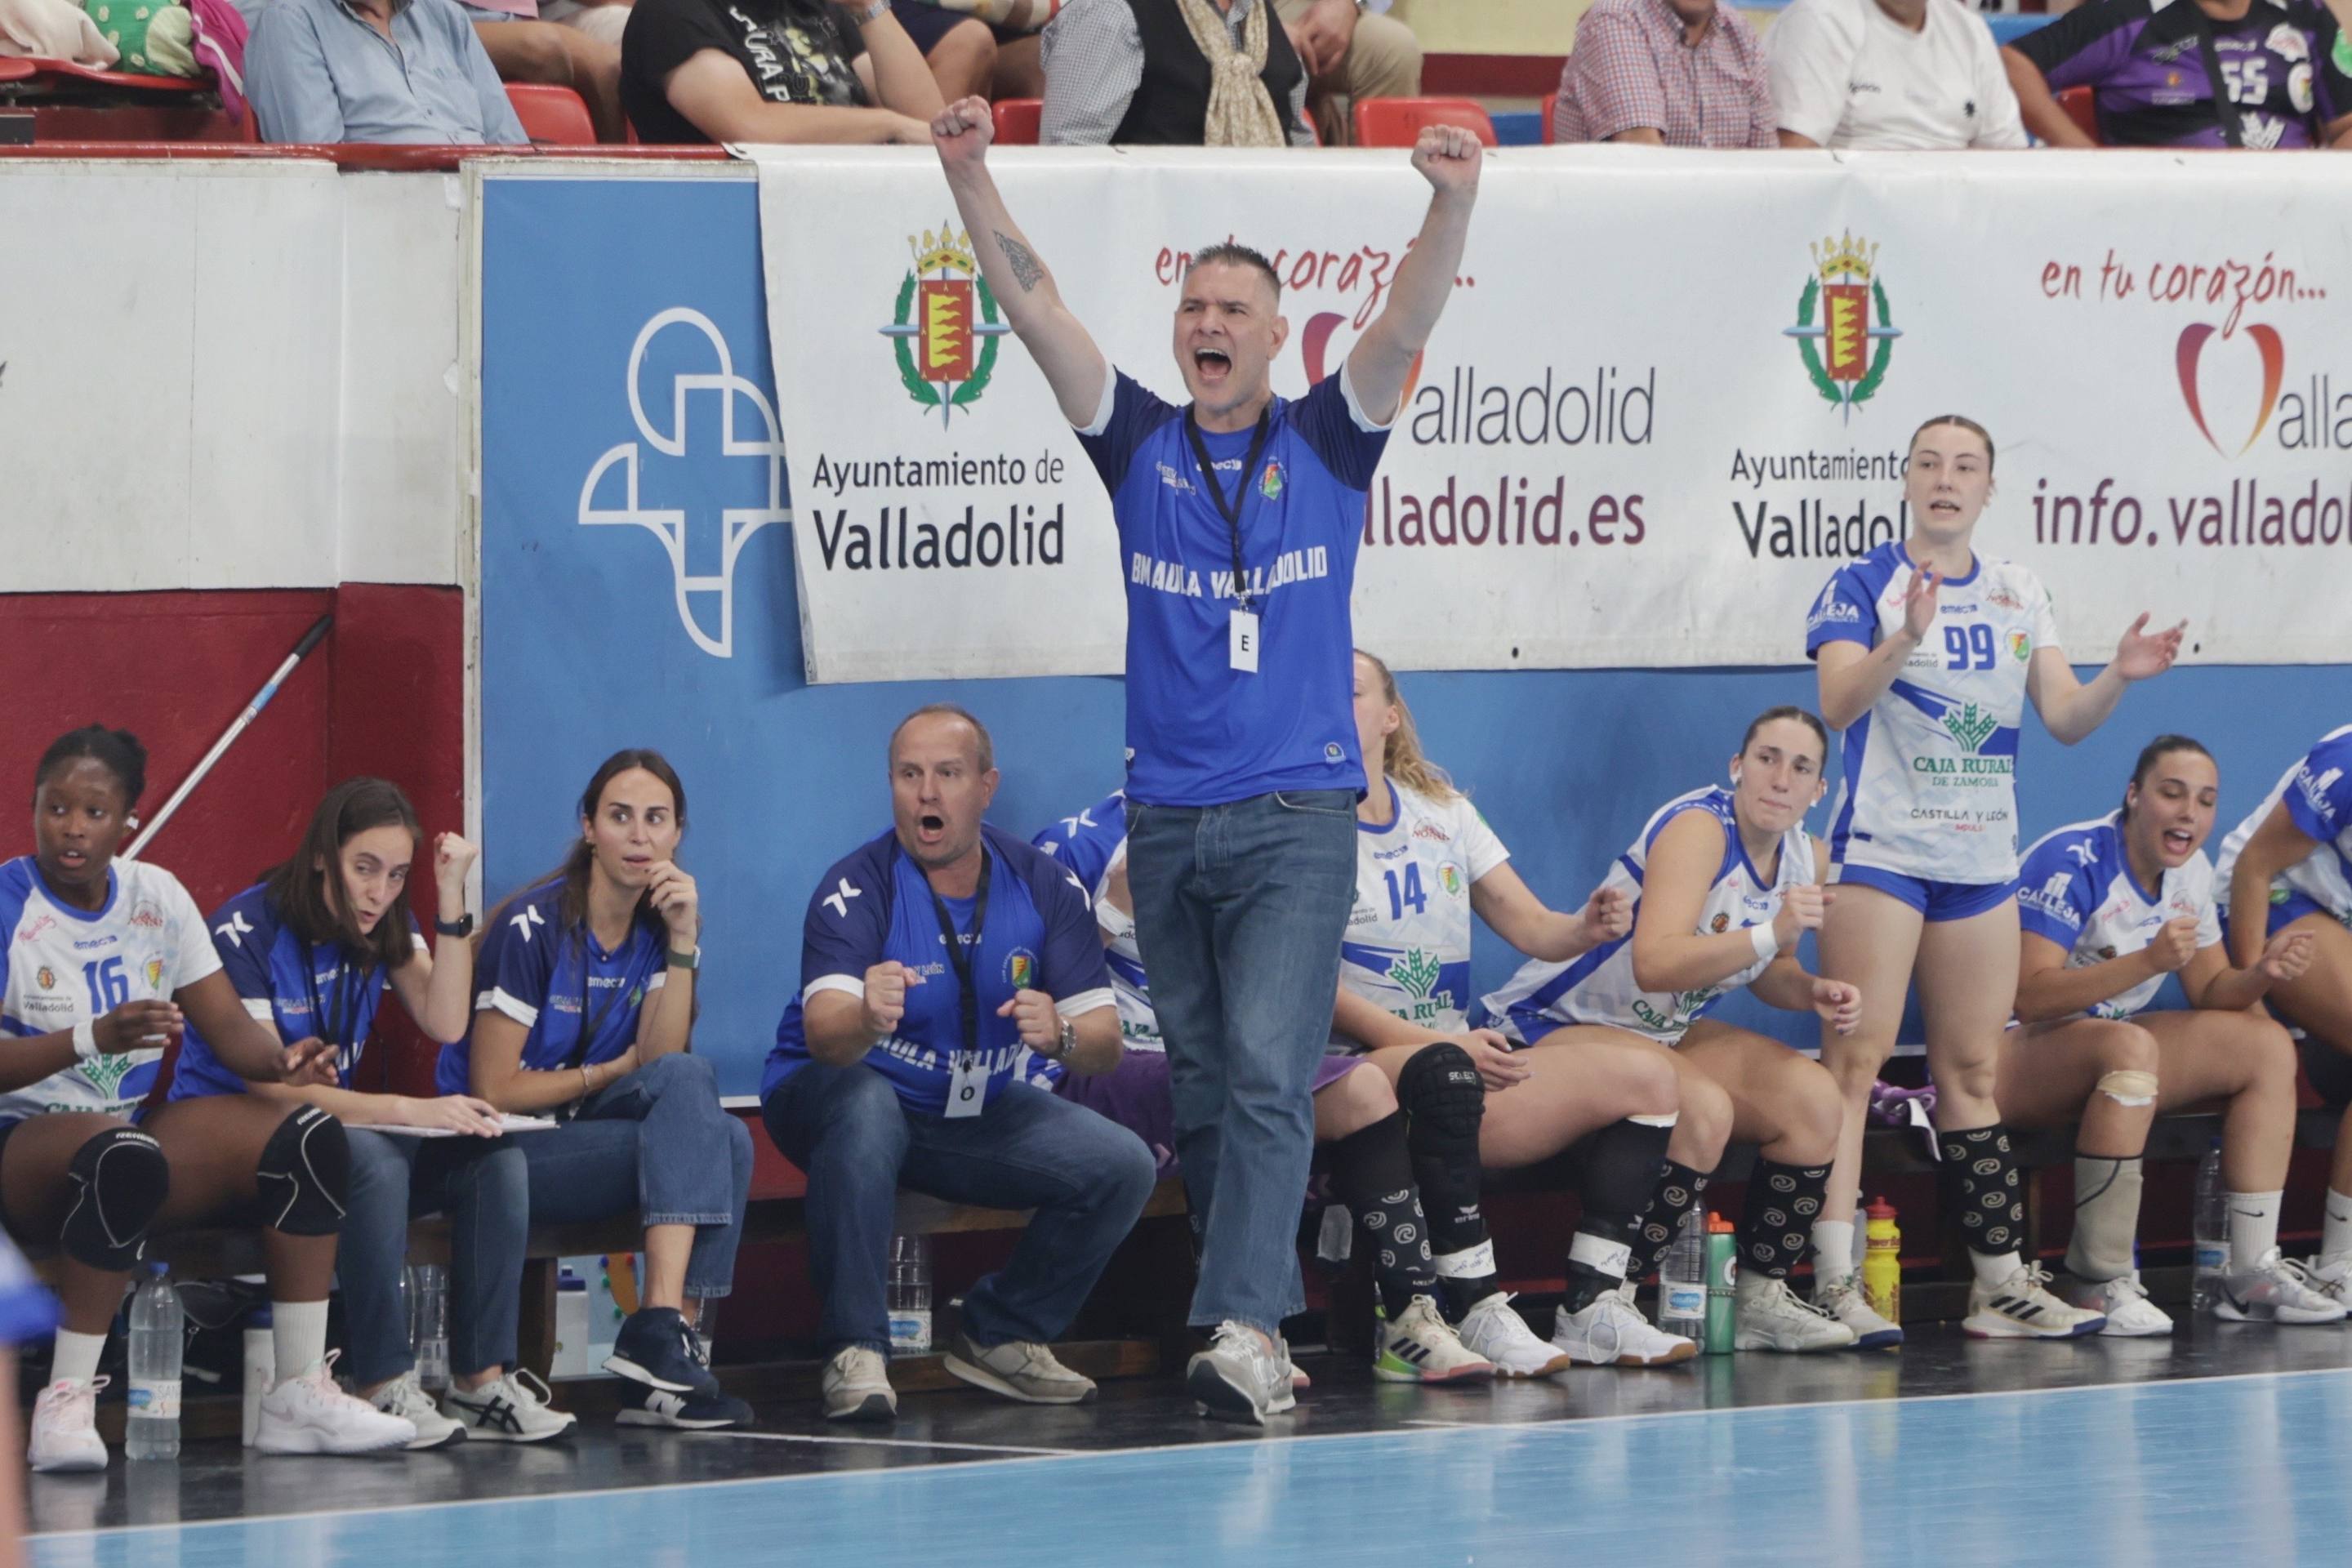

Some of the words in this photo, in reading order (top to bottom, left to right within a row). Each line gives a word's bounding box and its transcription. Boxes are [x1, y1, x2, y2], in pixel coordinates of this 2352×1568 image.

[2041, 261, 2082, 299] en
[2100, 248, 2135, 303] tu
[2147, 251, 2327, 341] corazón...
[812, 452, 1027, 498] Ayuntamiento
[1035, 448, 1064, 484] de
[812, 502, 1065, 571] Valladolid
[1731, 498, 1909, 559] Valladol
[2032, 477, 2352, 547] info.vallado
[1152, 560, 1203, 599] AULA
[1210, 546, 1328, 599] VALADOLID
[1241, 634, 1250, 653] E
[1943, 623, 1996, 671] 99
[1913, 755, 1957, 774] CAJA
[1962, 757, 2013, 774] RURAL
[1931, 776, 1949, 786] DE
[1910, 808, 1970, 821] CASTILLA
[1976, 810, 1984, 822] Y
[1383, 861, 1428, 921] 14
[82, 956, 129, 1014] 16
